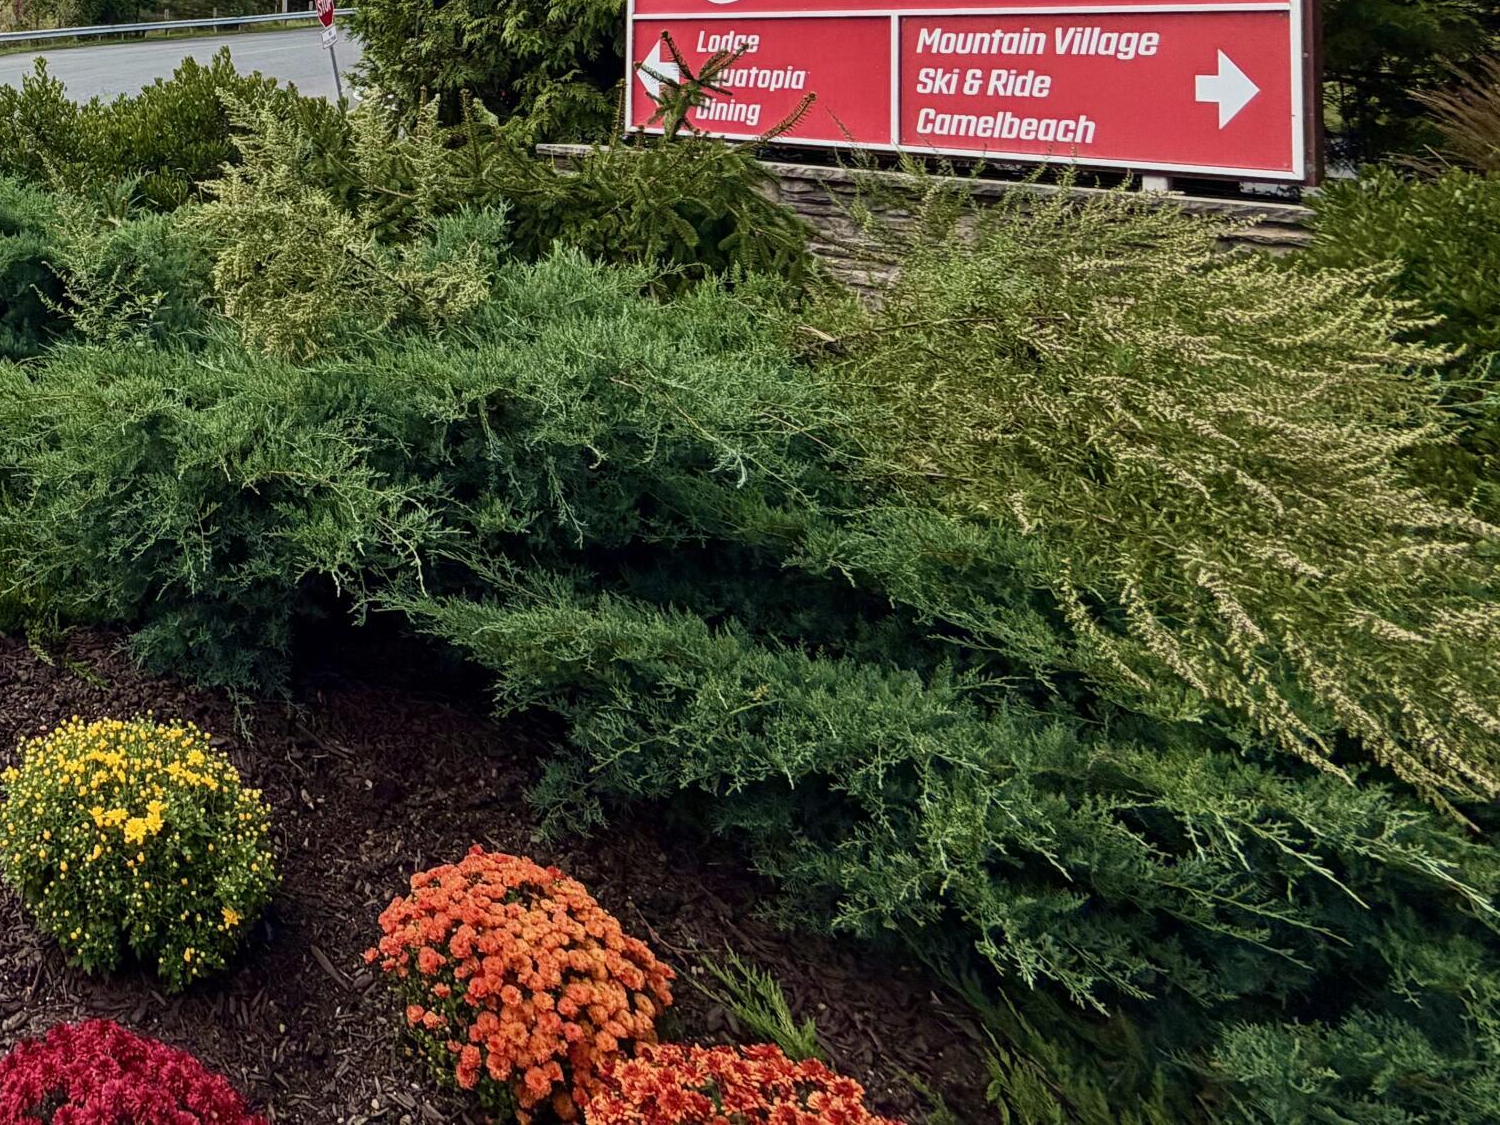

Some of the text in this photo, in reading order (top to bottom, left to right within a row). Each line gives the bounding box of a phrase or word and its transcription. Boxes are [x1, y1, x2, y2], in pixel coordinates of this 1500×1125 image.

[916, 27, 1160, 60] Mountain Village
[916, 68, 1052, 98] Ski & Ride
[916, 107, 1096, 144] Camelbeach
